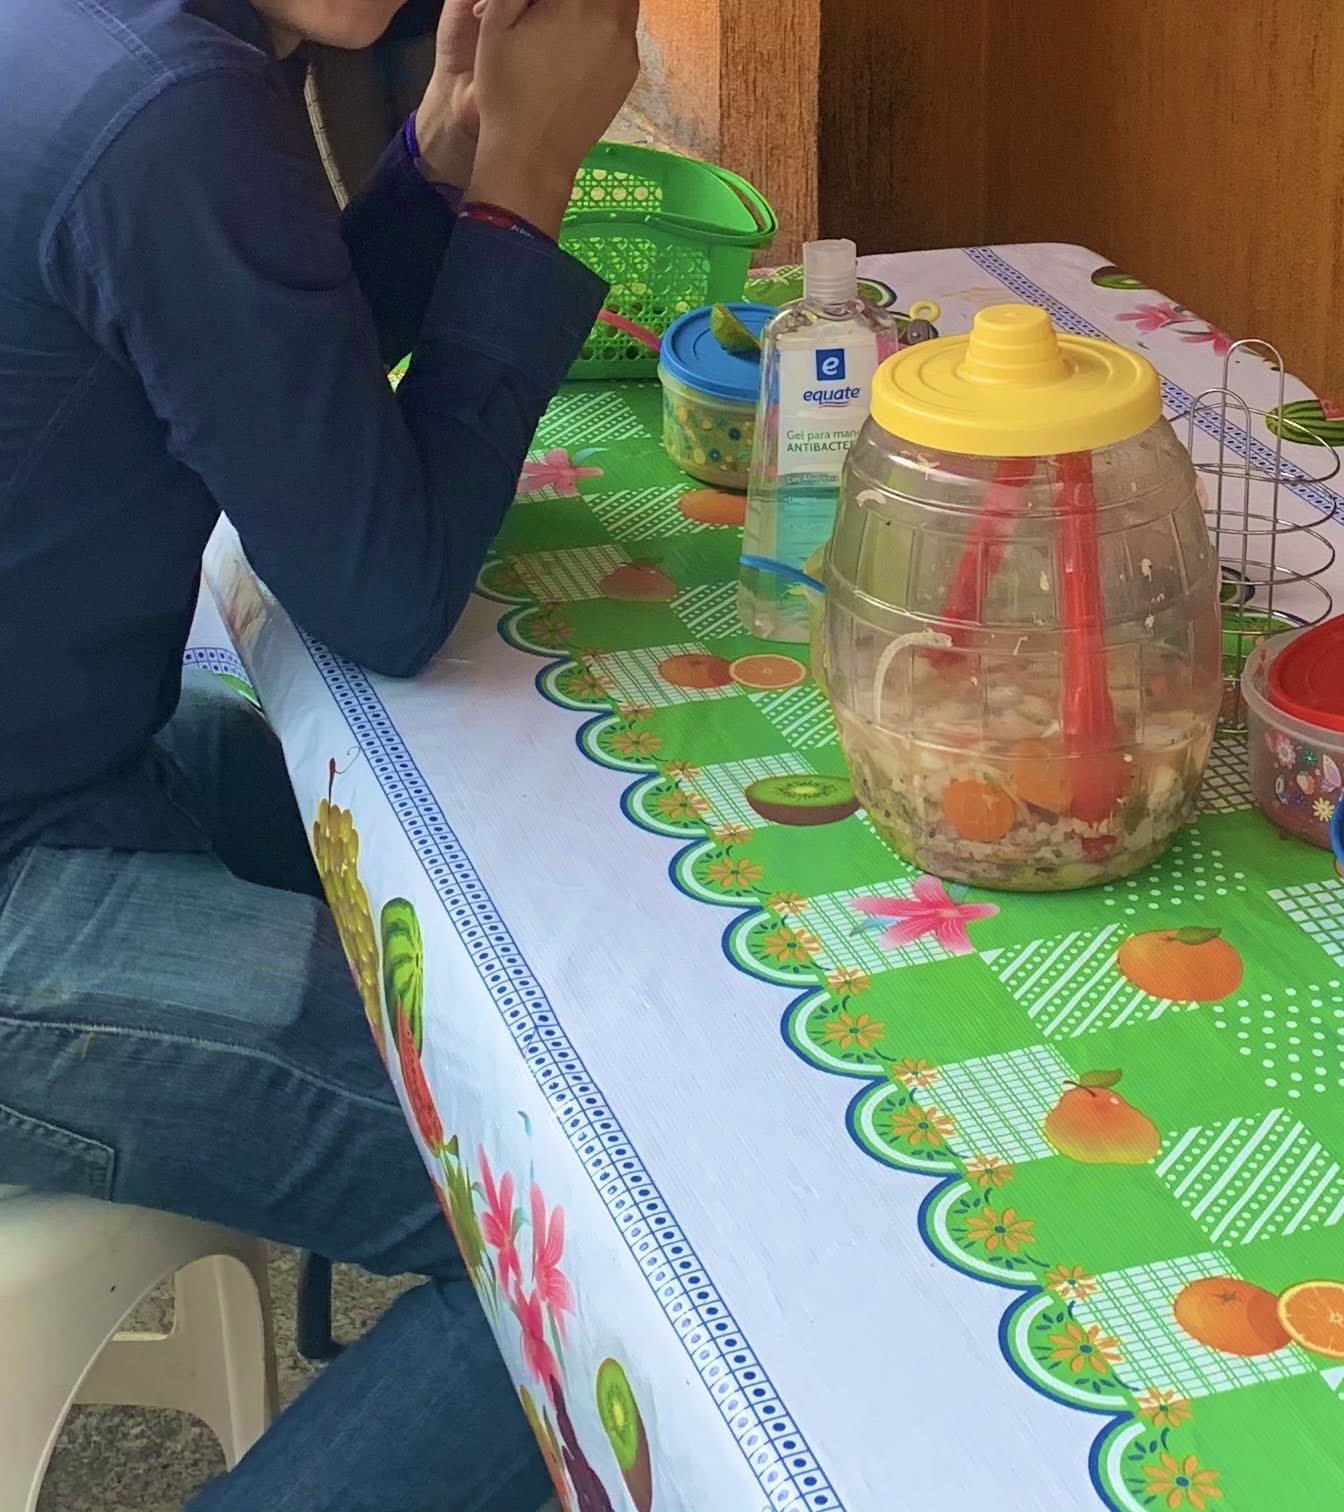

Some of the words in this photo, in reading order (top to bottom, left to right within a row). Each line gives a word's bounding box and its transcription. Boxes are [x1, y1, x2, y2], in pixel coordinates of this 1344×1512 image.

[821, 356, 840, 376] e
[803, 386, 861, 405] equate
[786, 430, 804, 440] Gel
[807, 431, 831, 442] para
